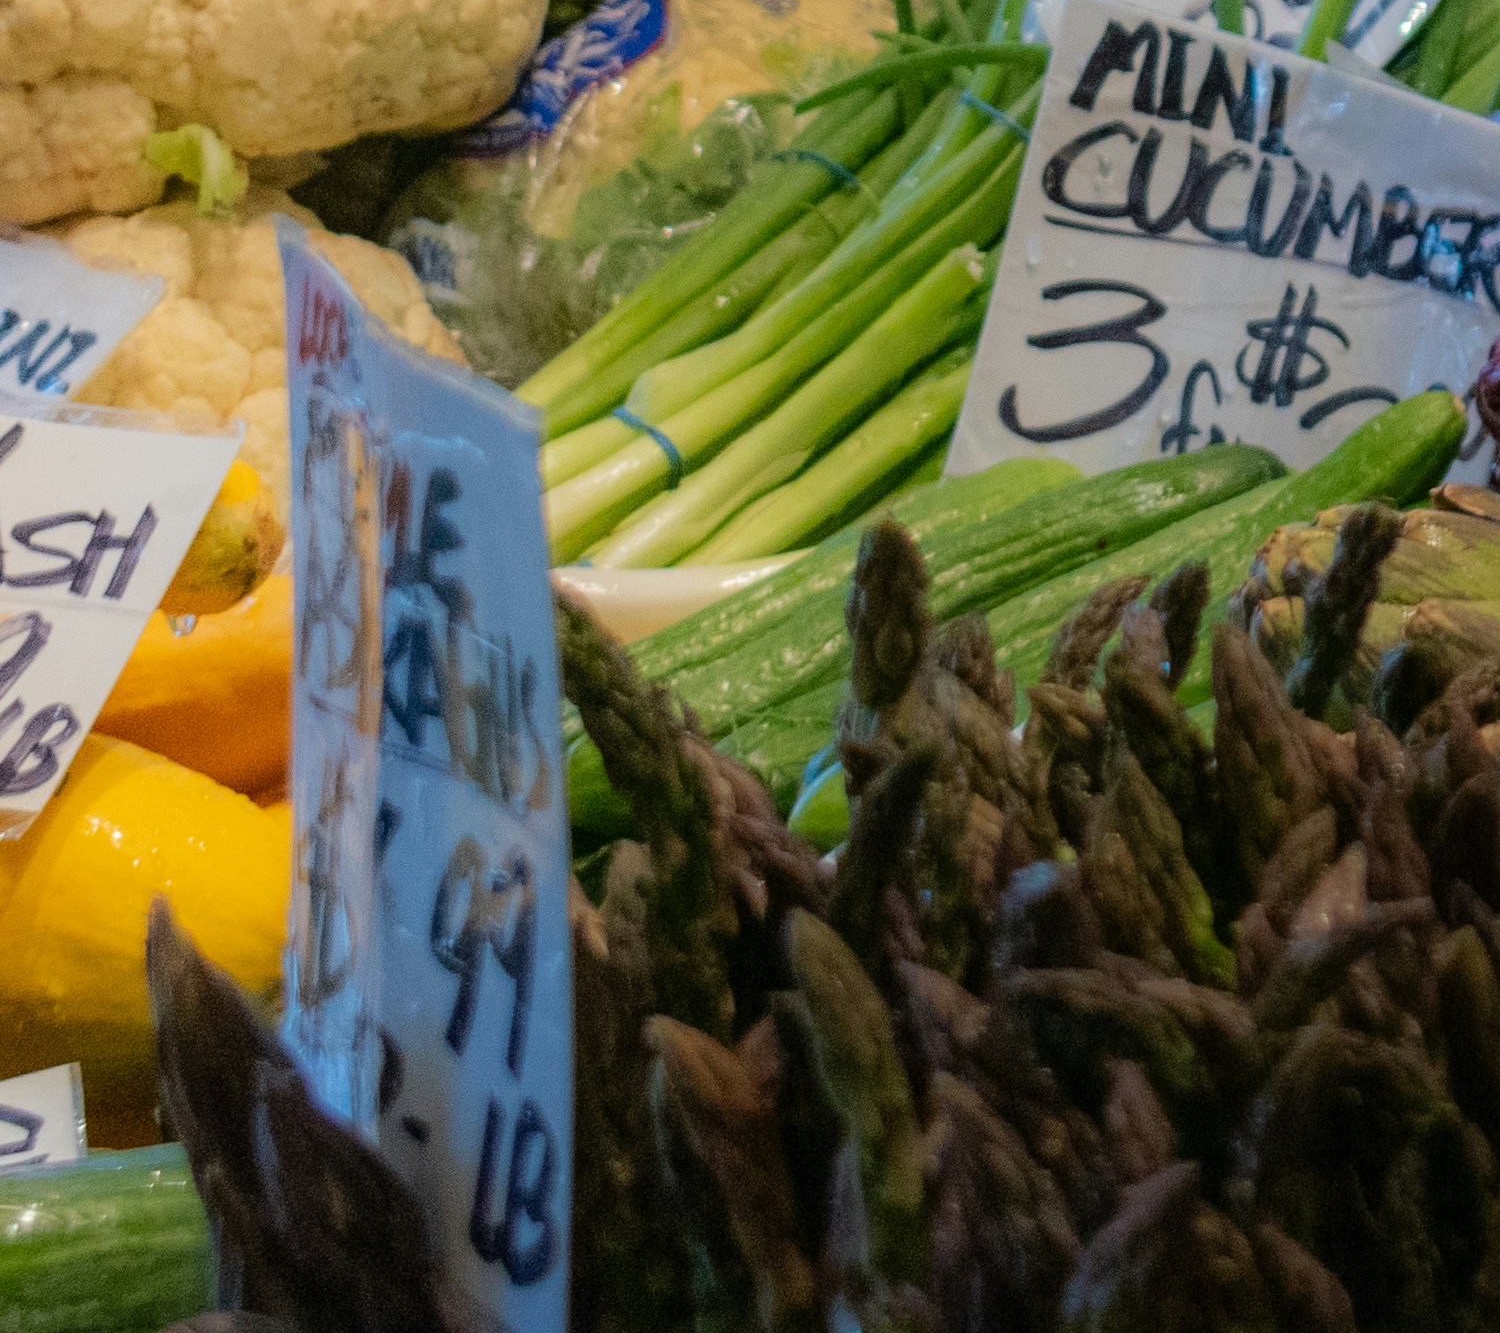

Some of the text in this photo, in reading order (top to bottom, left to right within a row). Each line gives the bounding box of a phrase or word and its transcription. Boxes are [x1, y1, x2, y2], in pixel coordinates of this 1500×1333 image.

[1068, 19, 1294, 157] MINI
[998, 278, 1170, 444] 3
[470, 1093, 560, 1289] LB
